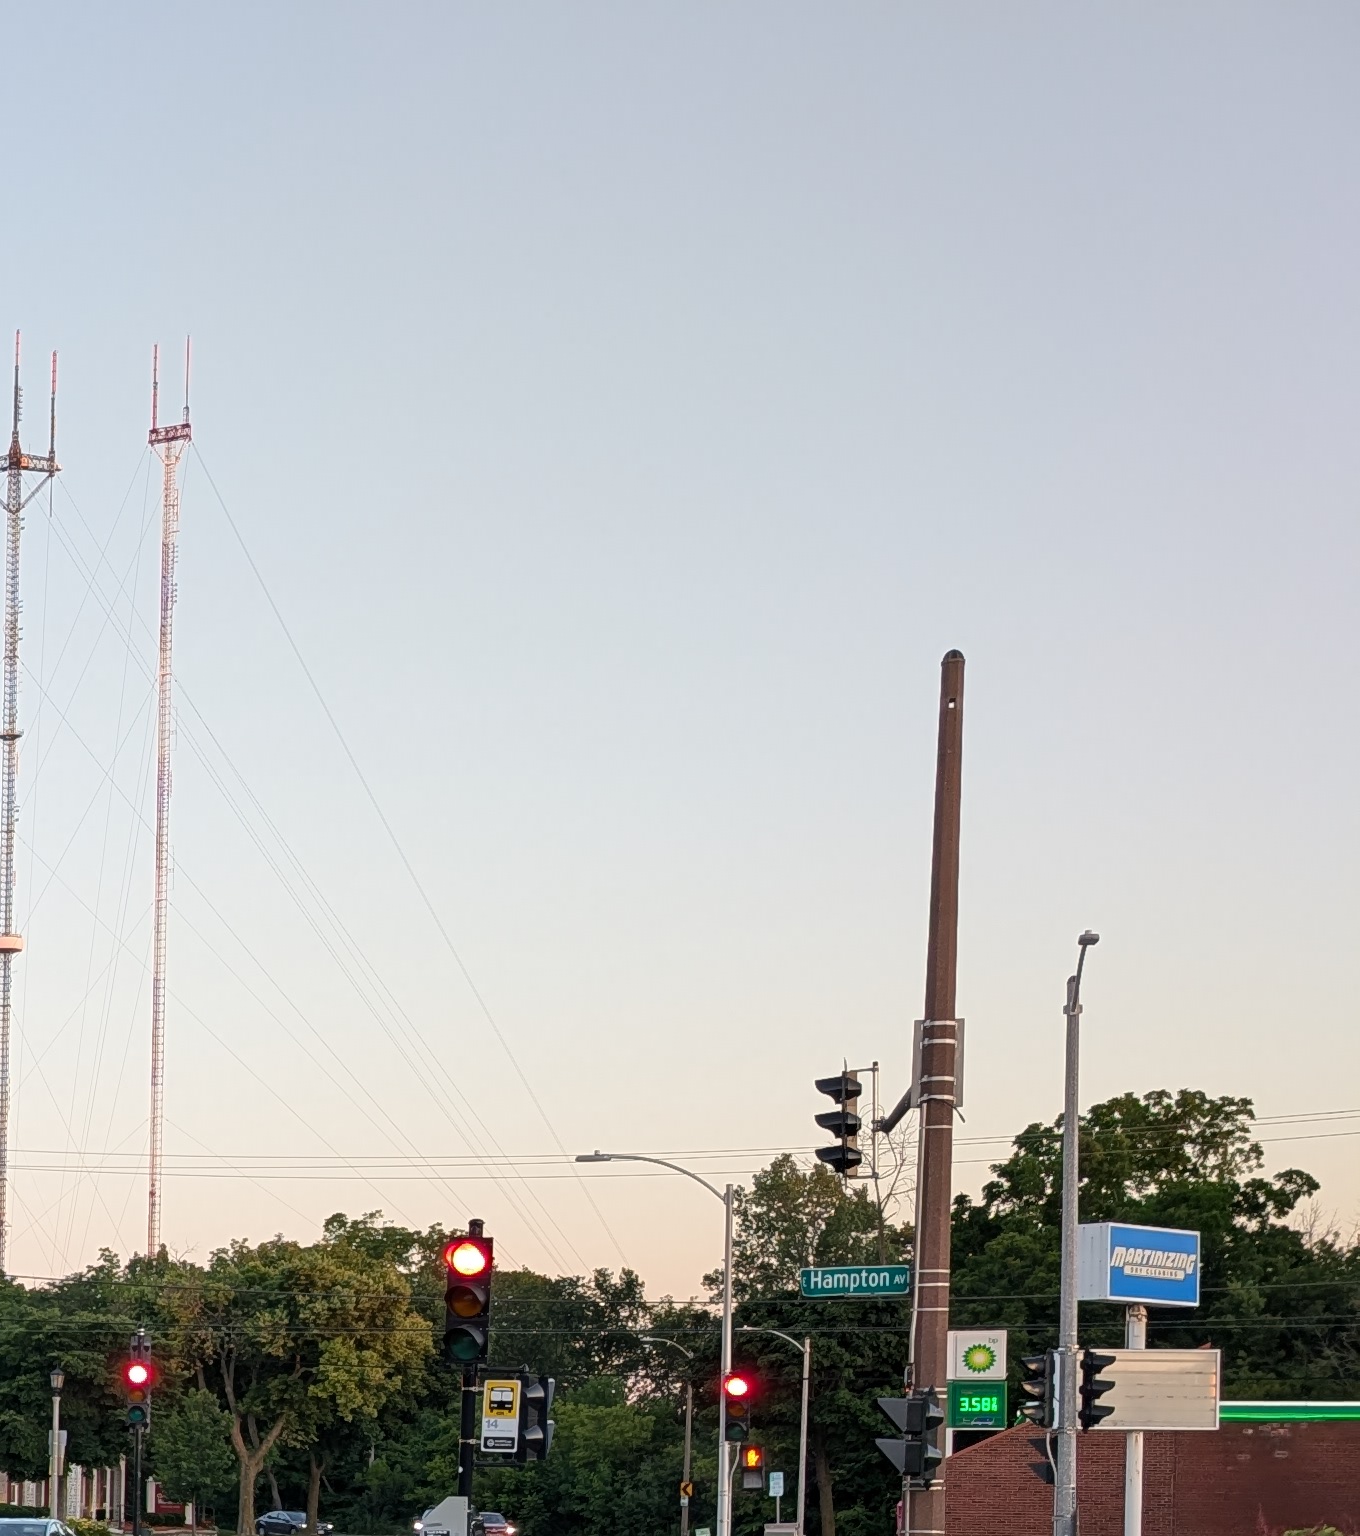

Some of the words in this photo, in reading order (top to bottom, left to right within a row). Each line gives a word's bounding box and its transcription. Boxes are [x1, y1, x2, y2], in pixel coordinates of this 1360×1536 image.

[1111, 1246, 1196, 1274] MARTINIZING
[810, 1269, 890, 1292] Hampton
[893, 1274, 906, 1284] AV
[485, 1419, 499, 1428] 14
